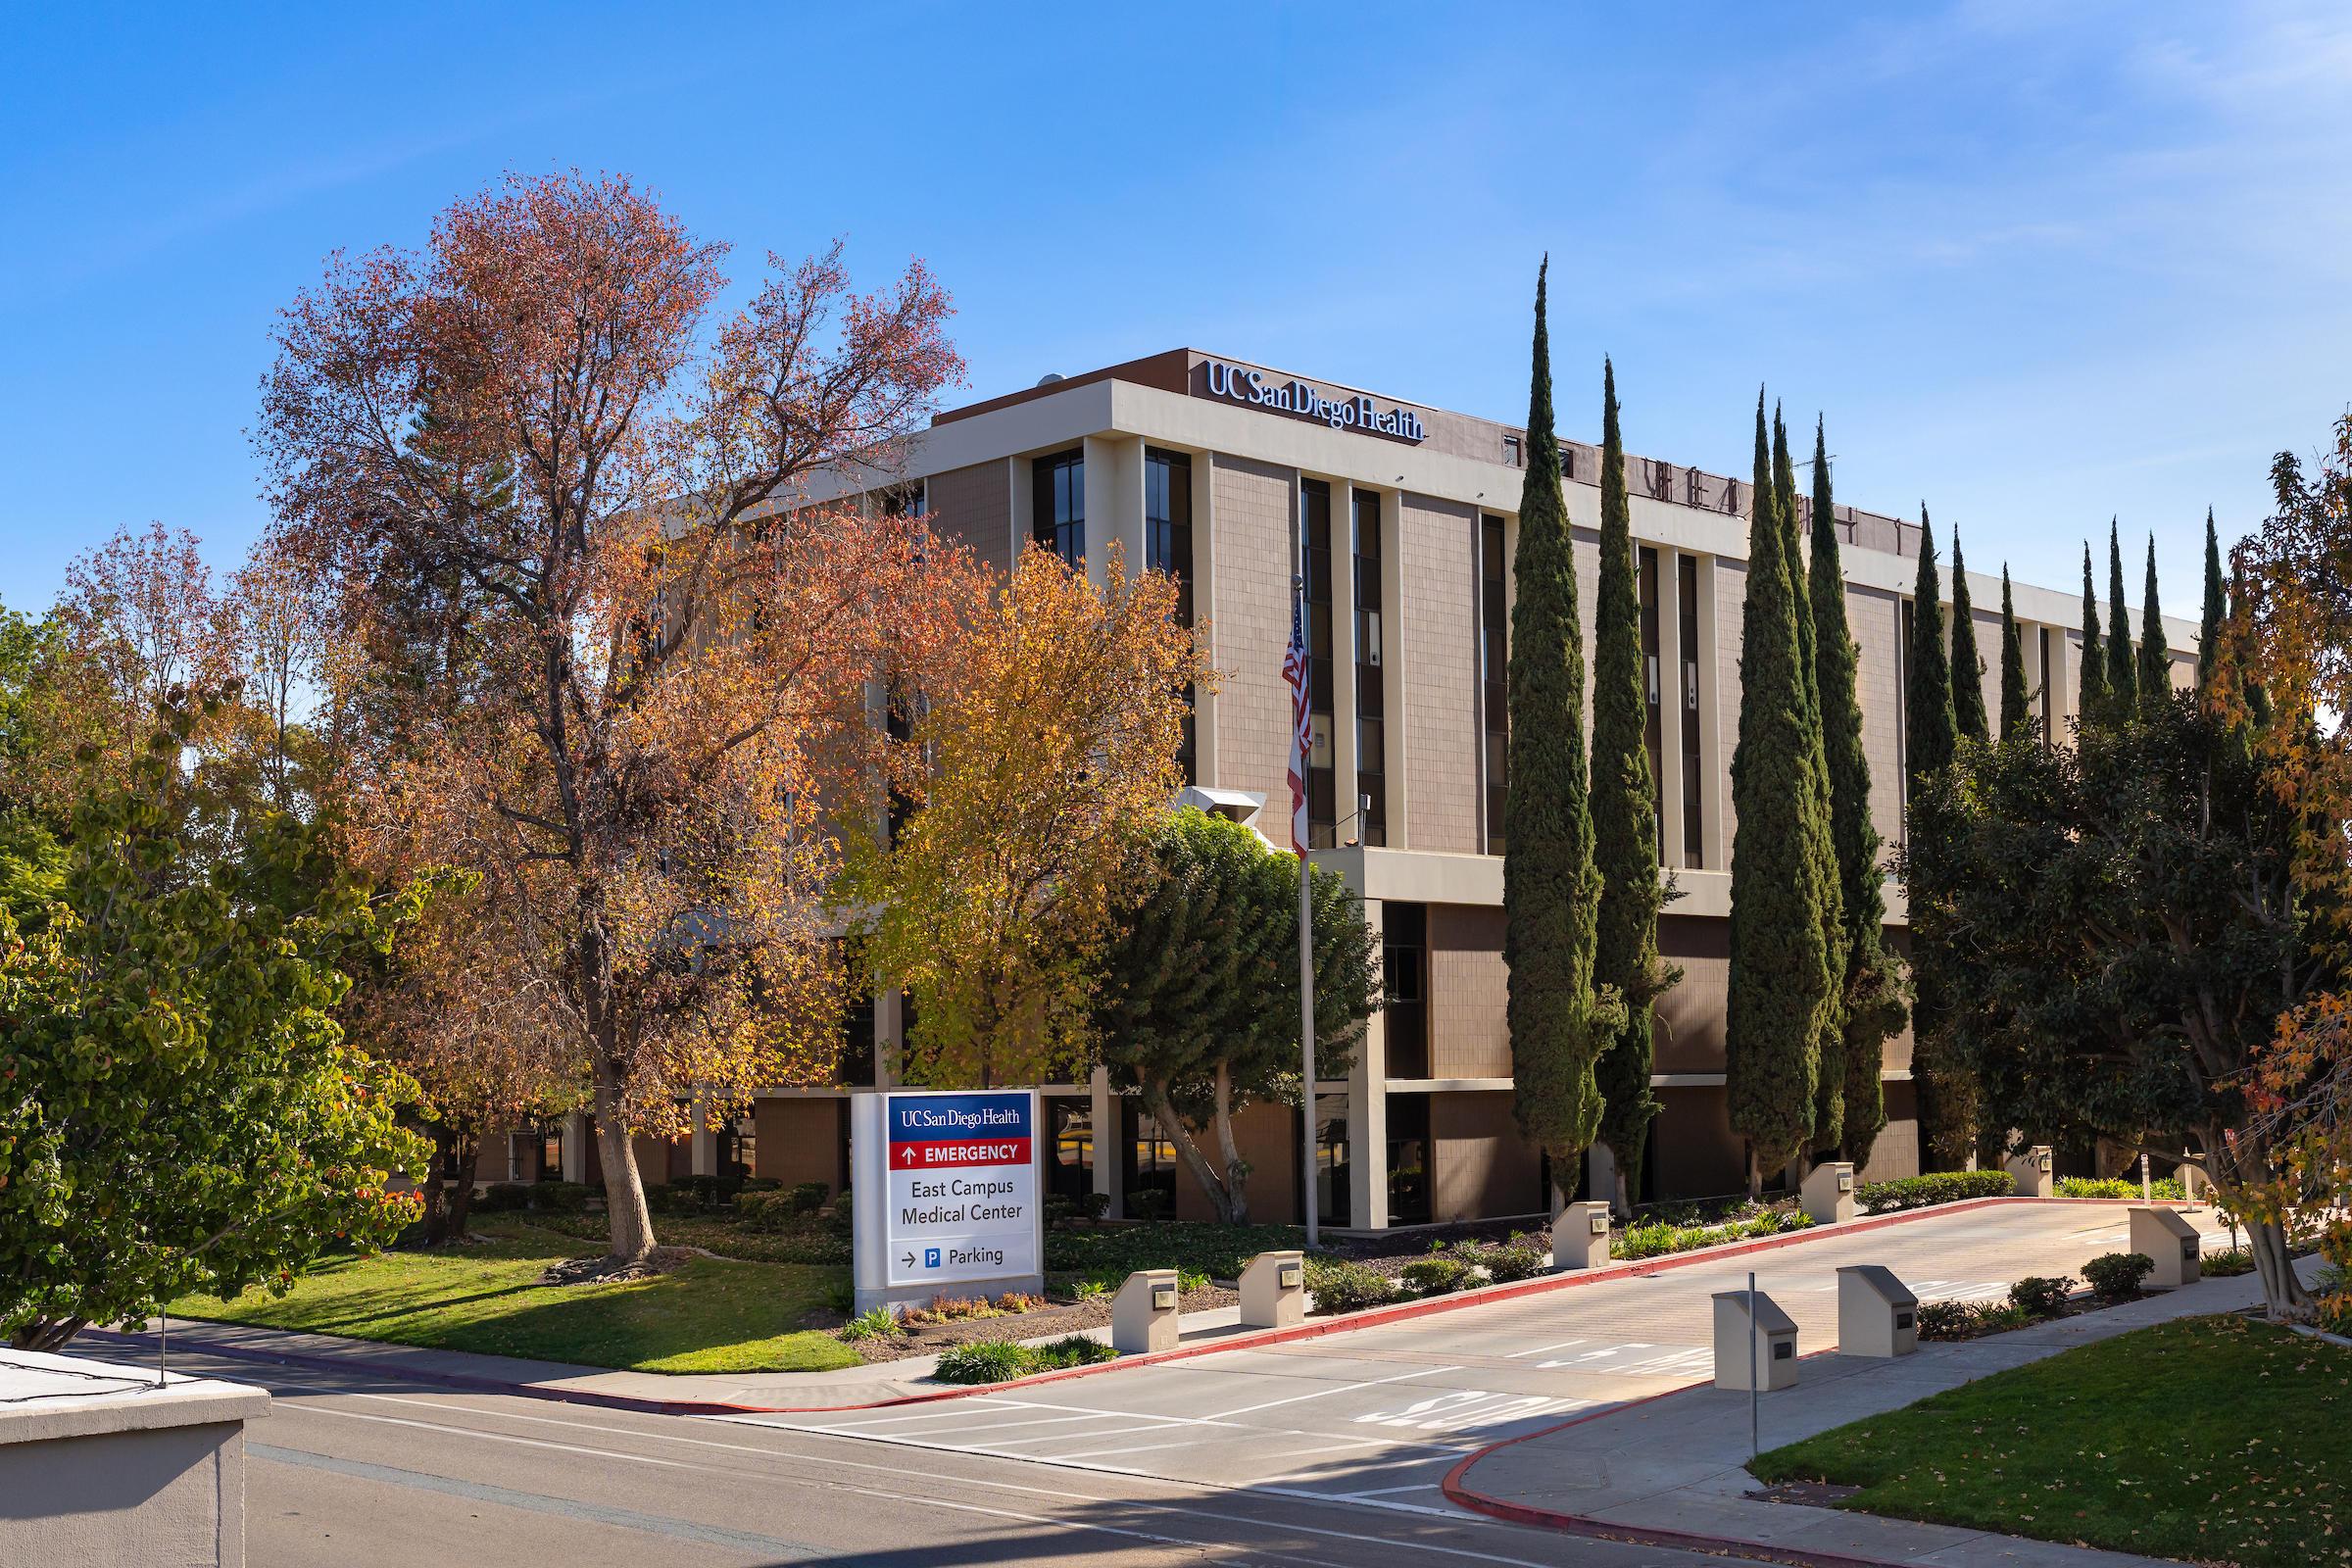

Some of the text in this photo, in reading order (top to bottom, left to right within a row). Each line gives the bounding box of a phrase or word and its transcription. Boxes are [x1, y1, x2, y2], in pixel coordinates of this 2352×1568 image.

[1206, 360, 1424, 441] UC San Diego Health
[902, 1108, 1020, 1129] UC San Diego Health
[925, 1144, 1018, 1162] EMERGENCY
[911, 1179, 1013, 1199] East Campus
[902, 1203, 1022, 1225] Medical Center
[928, 1247, 1004, 1265] P Parking
[1349, 1390, 1592, 1434] SLOW
